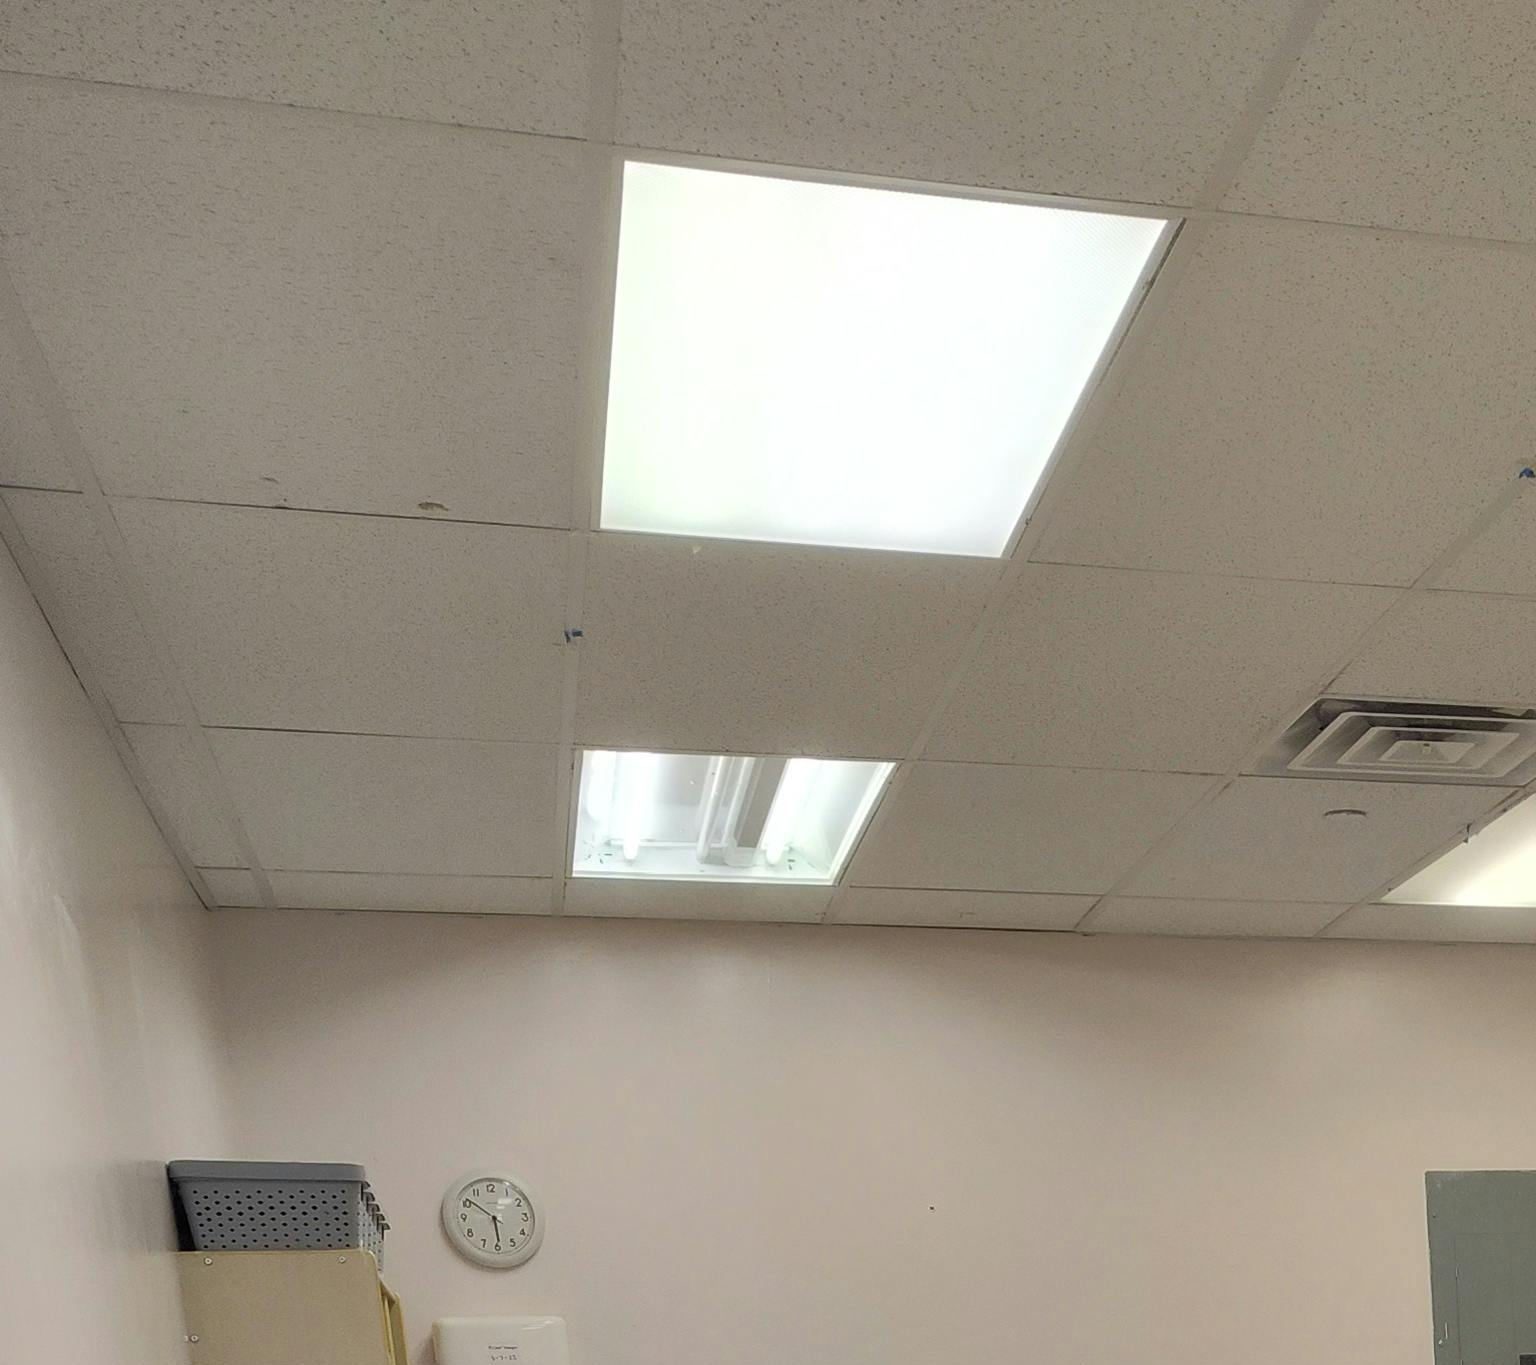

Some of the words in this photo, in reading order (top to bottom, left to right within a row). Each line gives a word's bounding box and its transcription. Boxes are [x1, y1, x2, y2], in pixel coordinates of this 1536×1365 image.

[472, 1188, 480, 1197] 11
[486, 1183, 496, 1193] 12
[505, 1188, 509, 1197] 1
[514, 1198, 522, 1208] 2
[460, 1213, 467, 1222] 9
[521, 1212, 529, 1222] 3
[466, 1228, 474, 1238] 8
[520, 1228, 526, 1236] 4
[480, 1239, 487, 1248] 7
[494, 1242, 501, 1251] 6
[509, 1238, 516, 1248] 5
